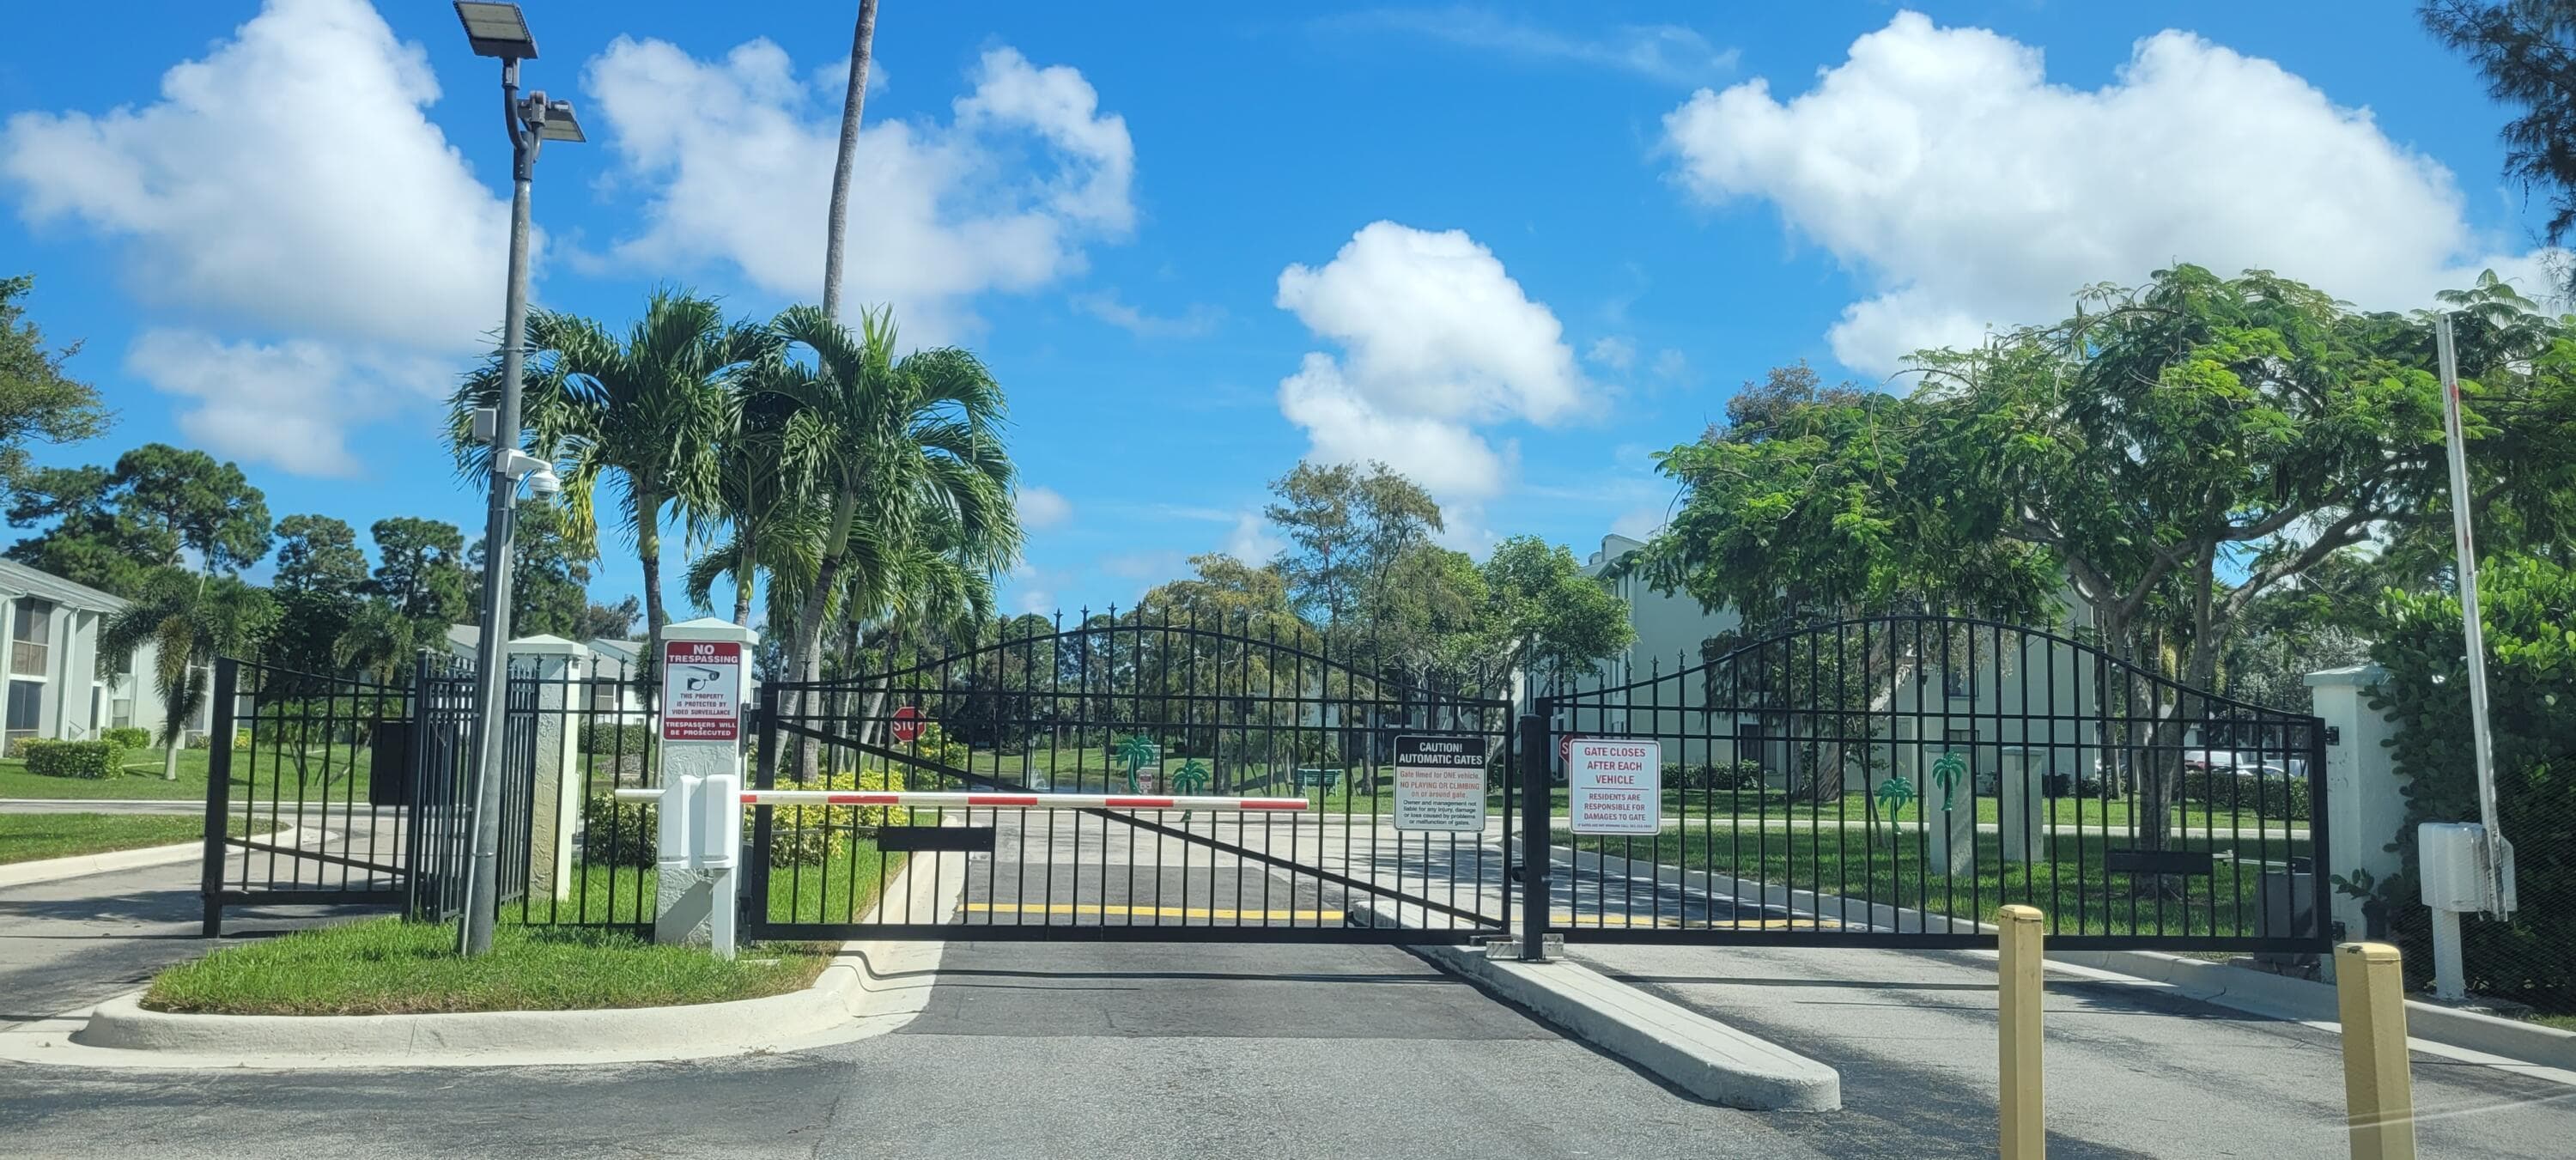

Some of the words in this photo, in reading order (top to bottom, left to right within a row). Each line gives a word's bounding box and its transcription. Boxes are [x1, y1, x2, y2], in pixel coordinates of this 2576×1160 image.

[694, 645, 714, 655] NO
[669, 655, 738, 664] TRESPASSING
[1419, 742, 1462, 752] CAUTION!
[1610, 748, 1645, 756] CLOSES
[1399, 754, 1451, 763] AUTOMATIC
[1454, 756, 1483, 765] GATES
[1587, 762, 1615, 770] AFTER
[1618, 762, 1642, 771] EACH
[1595, 774, 1635, 784] VEHICLE
